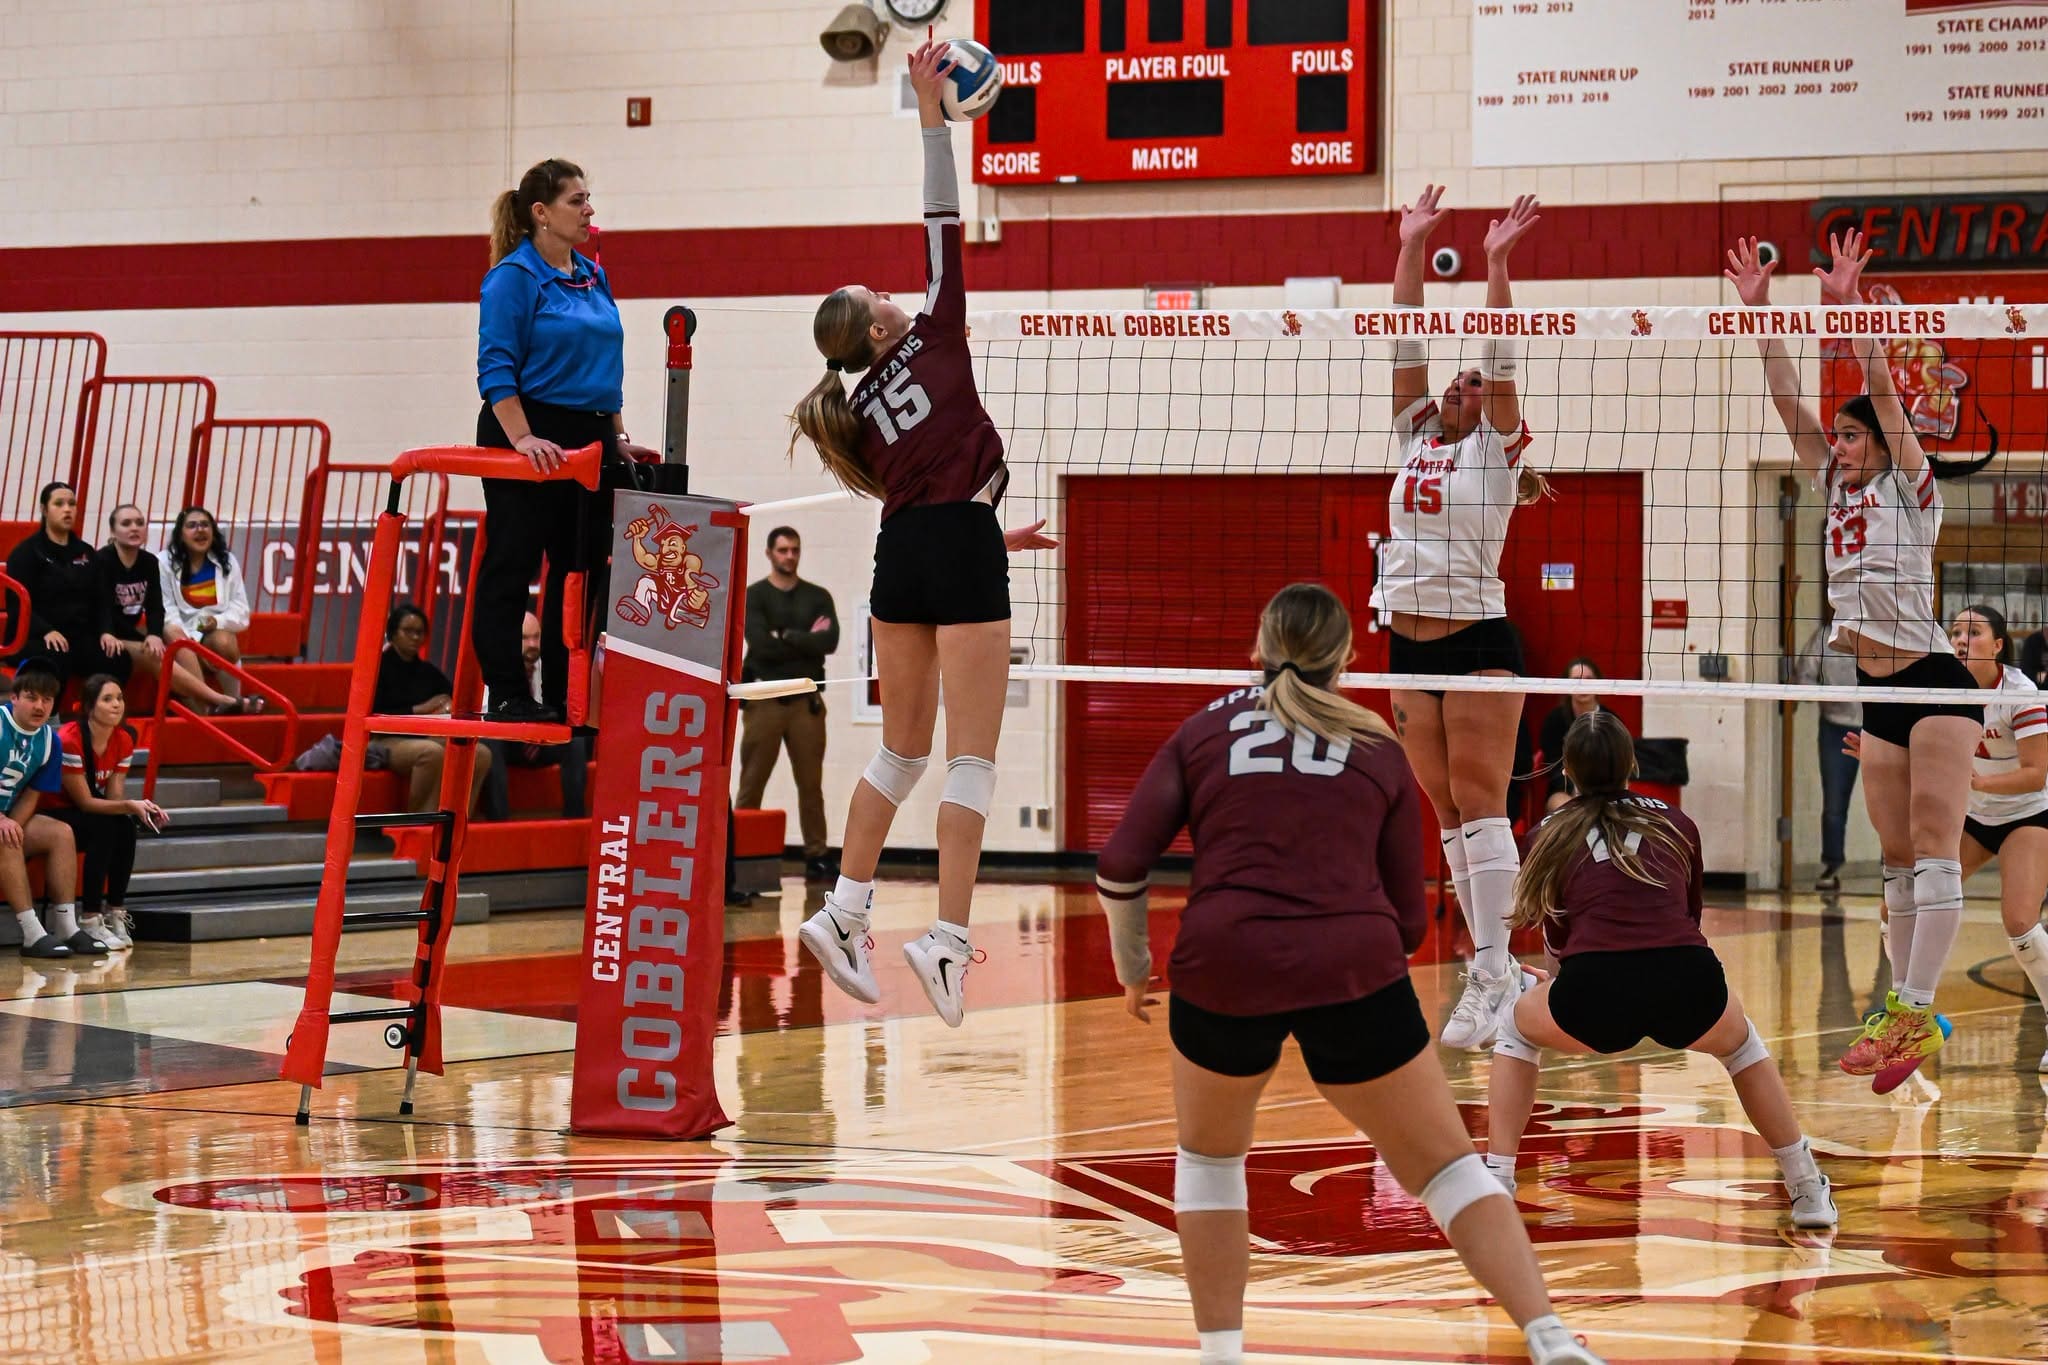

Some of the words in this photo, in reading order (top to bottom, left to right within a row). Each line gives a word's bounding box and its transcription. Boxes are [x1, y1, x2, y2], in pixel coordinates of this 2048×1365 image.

[1478, 5, 1503, 16] 1991
[1512, 4, 1538, 15] 1992
[1546, 2, 1574, 13] 2012
[1688, 9, 1716, 21] 2012
[1937, 18, 1984, 34] STATE
[1905, 44, 1933, 56] 1991
[1978, 41, 2008, 53] 2000
[2016, 39, 2046, 51] 2012
[998, 61, 1042, 85] OULS
[1106, 57, 1177, 81] PLAYER
[1182, 54, 1230, 78] FOUL
[1291, 49, 1354, 74] FOULS
[1728, 61, 1769, 76] STATE
[1772, 59, 1831, 74] RUNNER
[1834, 58, 1854, 72] UP
[1517, 70, 1556, 85] STATE
[1560, 68, 1616, 83] RUNNER
[1619, 67, 1639, 81] UP
[1512, 94, 1538, 105] 2011
[1546, 93, 1573, 104] 2013
[1688, 87, 1715, 98] 1989
[1723, 85, 1750, 97] 2001
[1758, 84, 1786, 96] 2002
[1794, 83, 1822, 95] 2003
[1830, 82, 1858, 94] 2007
[1947, 85, 1990, 100] STATE
[1994, 83, 2048, 98] RUNNE
[1905, 111, 1933, 123] 1992
[1943, 109, 1971, 121] 1998
[1980, 108, 2008, 120] 1999
[2016, 107, 2045, 119] 2021
[981, 152, 1041, 175] SCORE
[1132, 147, 1198, 171] MATCH
[1290, 141, 1353, 166] SCORE
[1020, 314, 1117, 337] CENTRAL
[1123, 314, 1231, 337] COBBLERS
[1354, 312, 1456, 336] CENTRAL
[1462, 312, 1576, 336] COBBLERS
[1708, 311, 1817, 335] CENTRAL
[1825, 310, 1946, 334] COBBLERS
[850, 334, 924, 412] PARTANS
[863, 366, 932, 446] 15
[1403, 476, 1442, 515] 15
[1831, 516, 1867, 558] 13
[263, 541, 462, 594] CENTR
[1229, 710, 1352, 776] 20
[592, 815, 631, 982] CENTRAL
[617, 691, 706, 1112] COBBLERS
